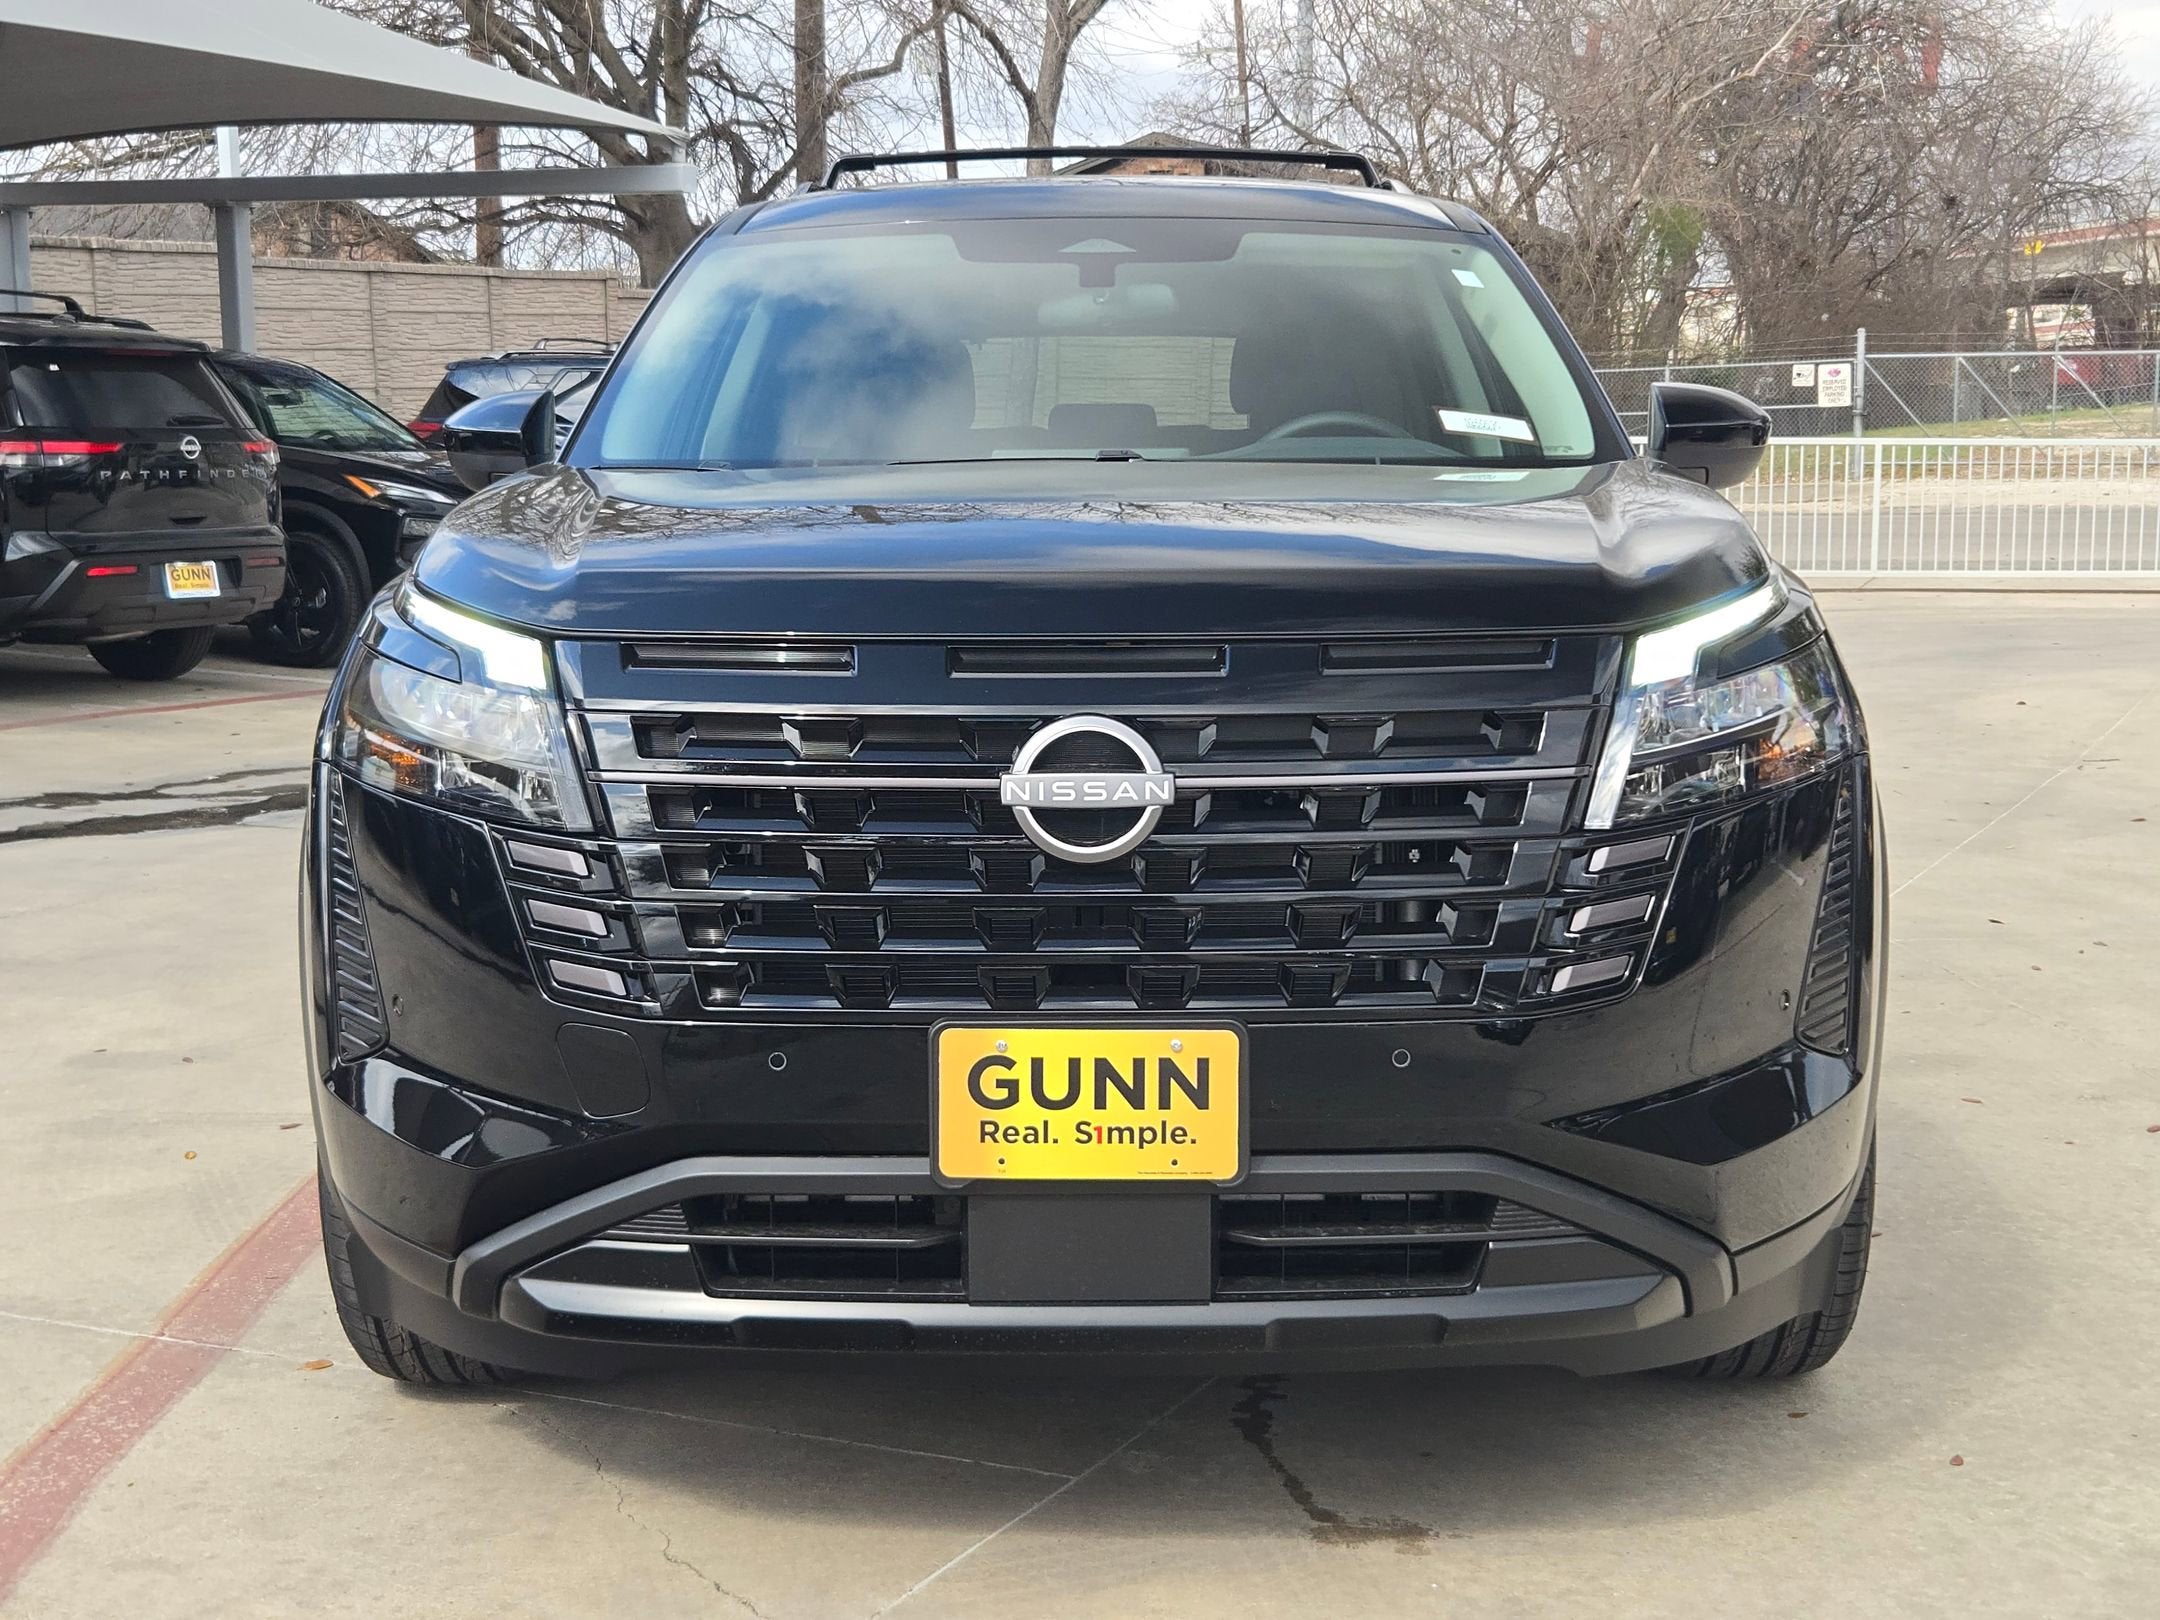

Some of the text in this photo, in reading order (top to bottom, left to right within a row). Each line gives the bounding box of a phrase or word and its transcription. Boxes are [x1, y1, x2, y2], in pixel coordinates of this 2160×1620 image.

[171, 568, 211, 581] GUNN
[1006, 780, 1169, 801] NISSAN
[967, 1055, 1210, 1111] GUNN
[979, 1120, 1059, 1144] Real.
